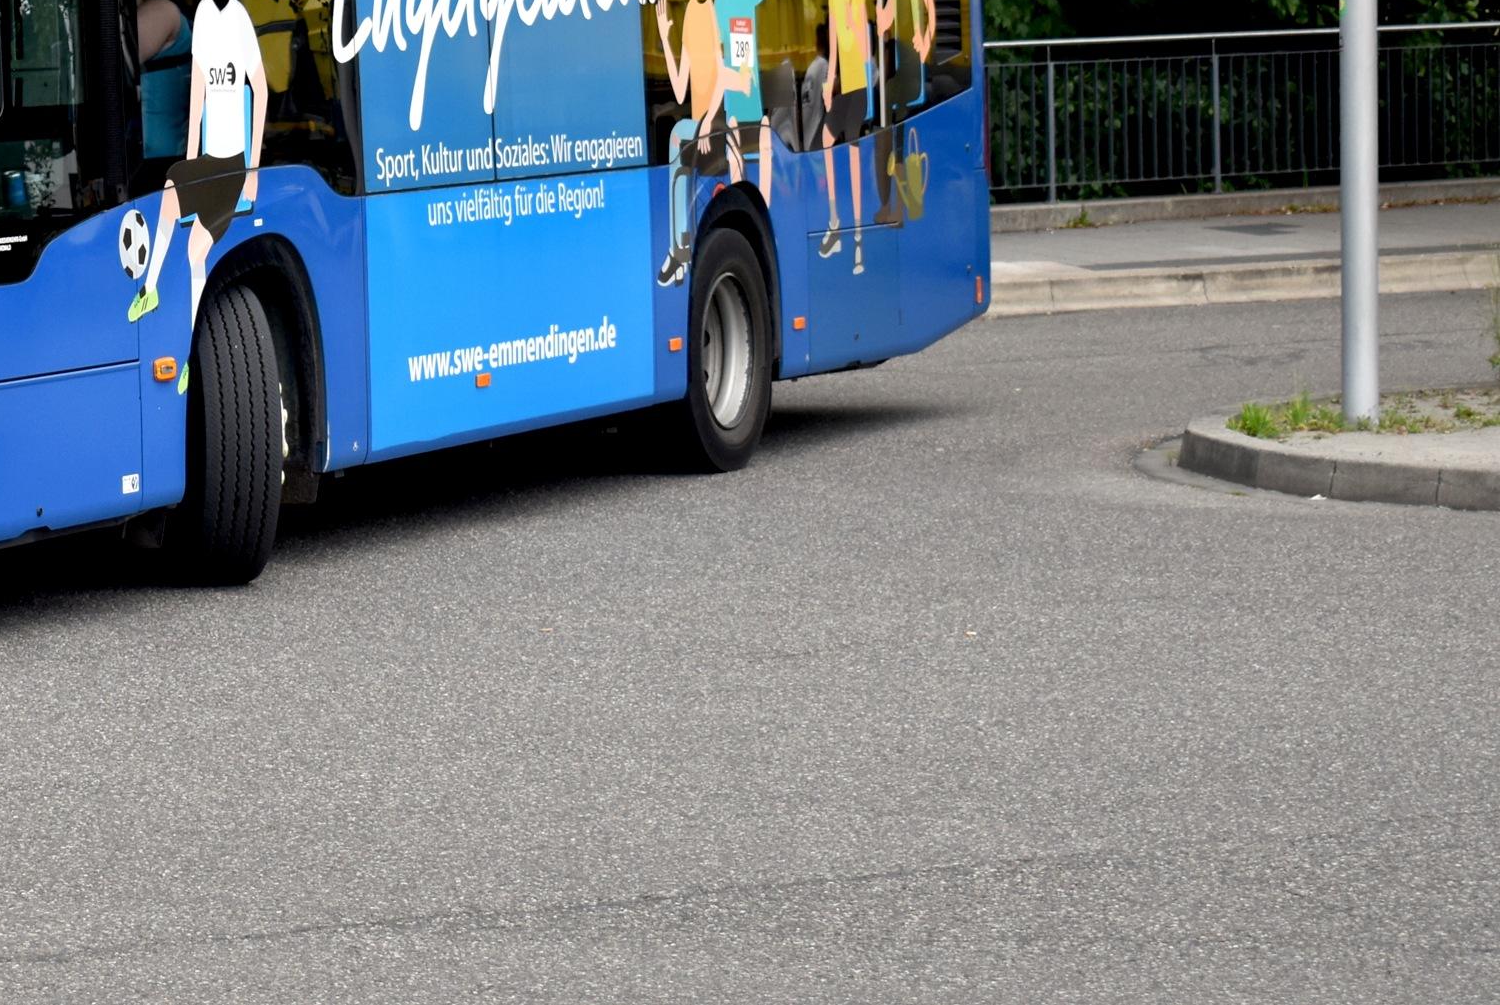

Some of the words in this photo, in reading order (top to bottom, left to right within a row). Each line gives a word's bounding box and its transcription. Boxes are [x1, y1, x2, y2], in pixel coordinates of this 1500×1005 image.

[376, 147, 419, 187] Sport,
[421, 141, 463, 175] Kultur
[466, 137, 493, 171] und
[495, 134, 550, 169] Soziales:
[550, 133, 572, 164] Wir
[574, 130, 643, 169] engagieren
[427, 200, 453, 226] uns
[454, 187, 512, 226] vielfältig
[514, 185, 533, 216] für
[535, 182, 556, 214] die
[557, 179, 604, 219] Region!
[408, 315, 616, 382] www.swe-emmendingen.de
